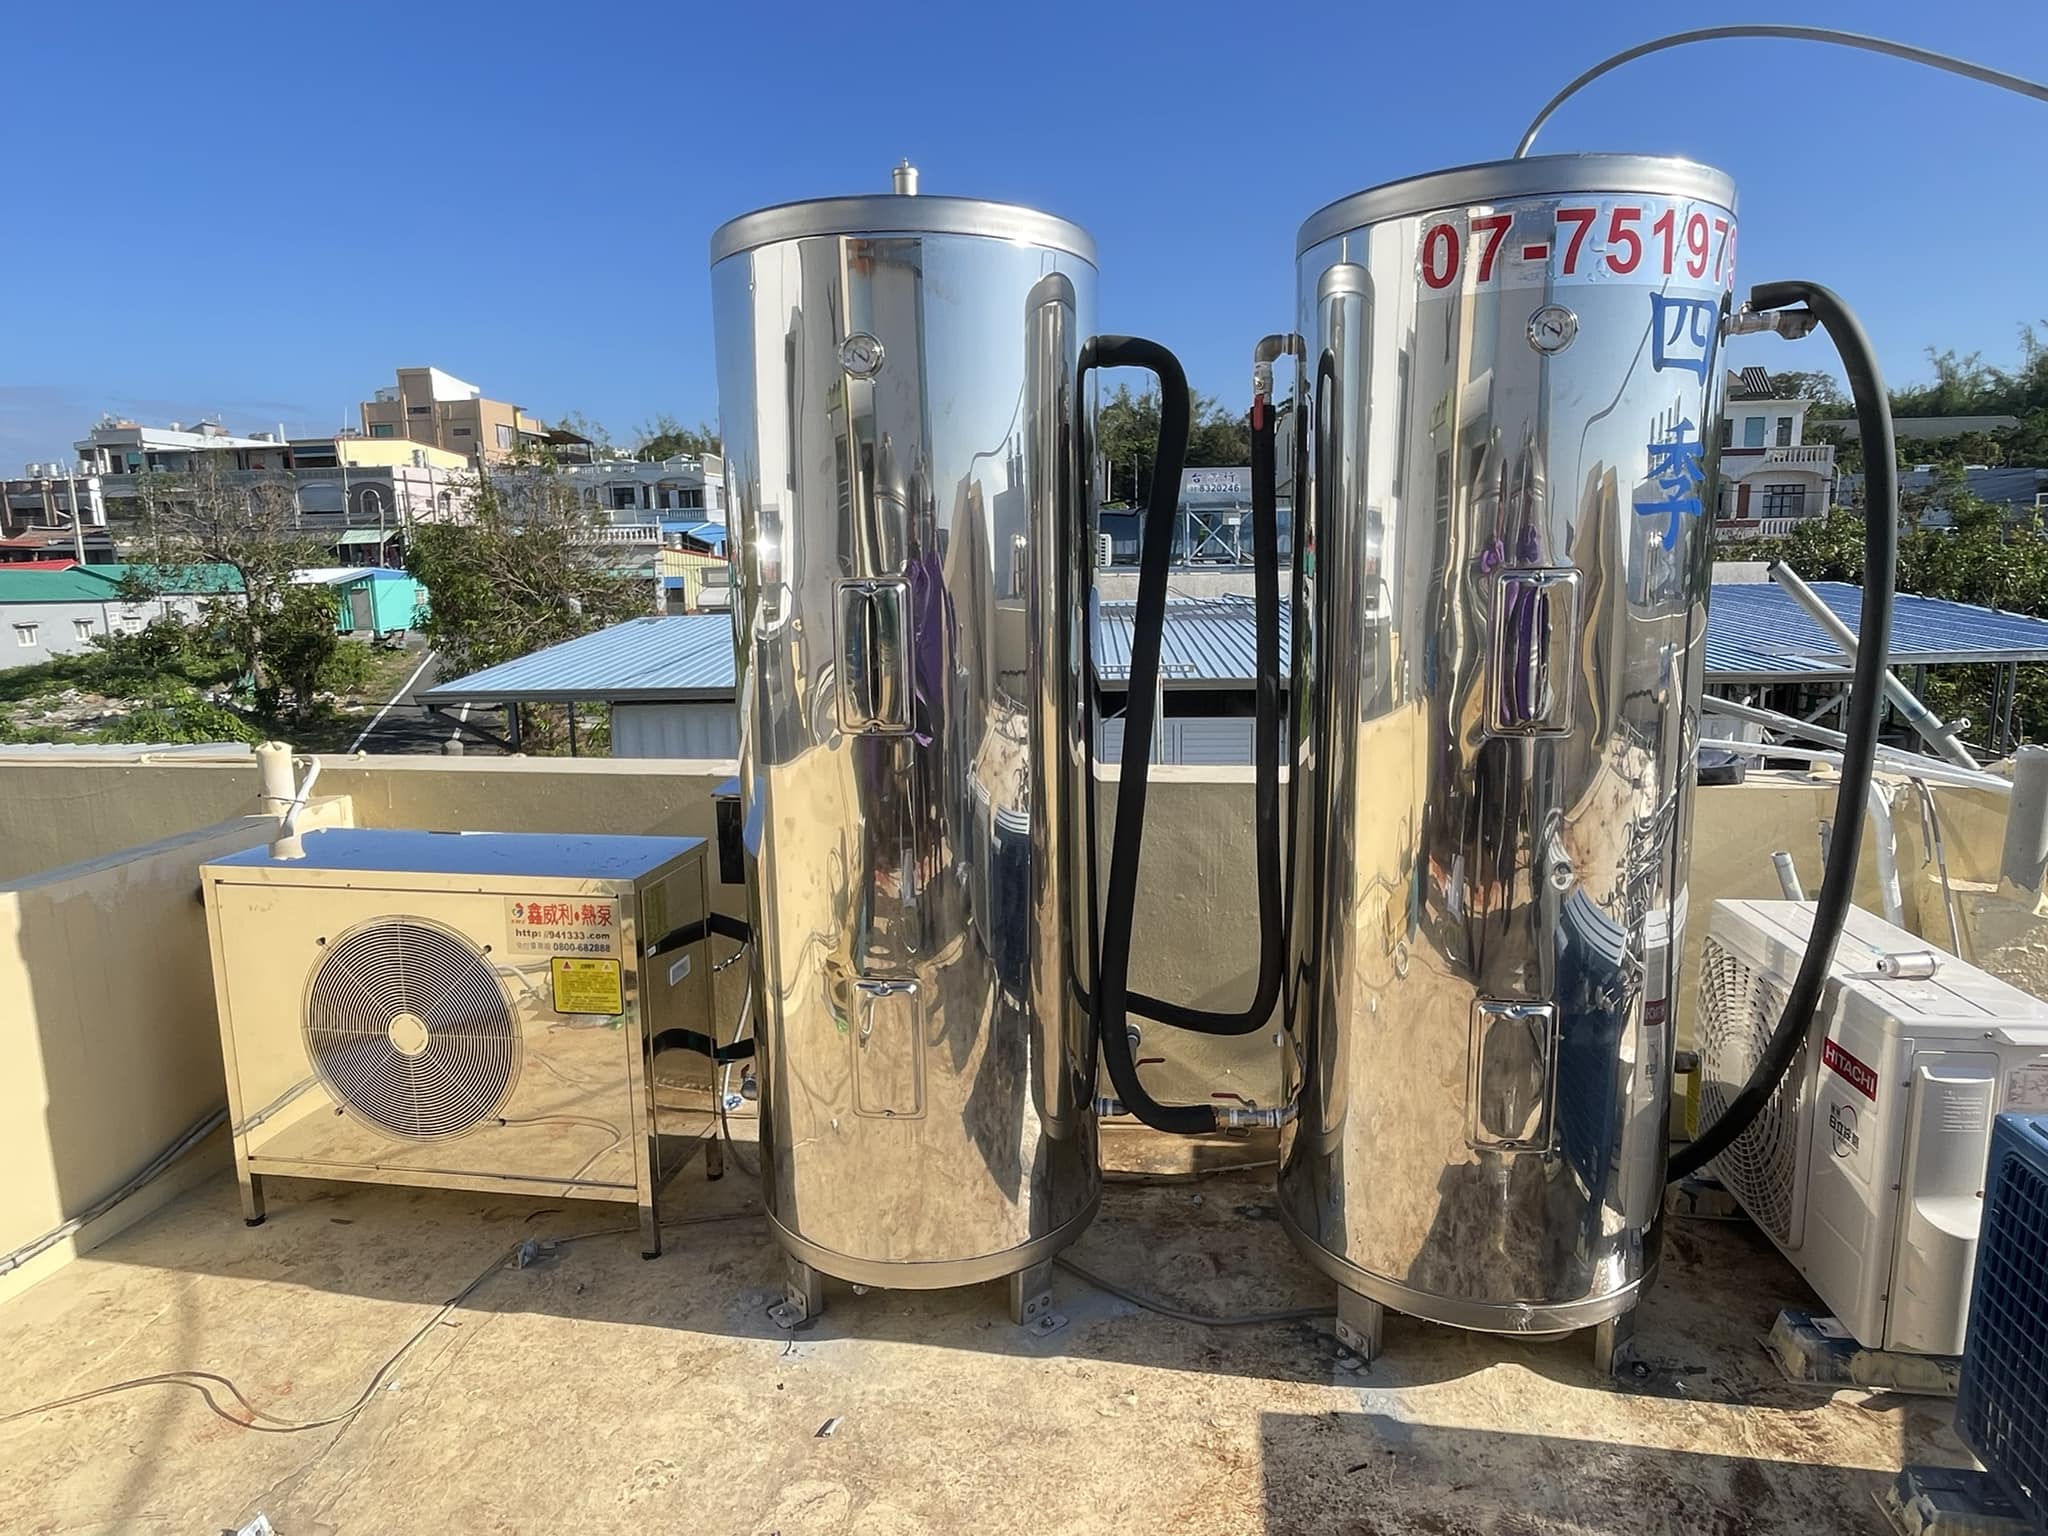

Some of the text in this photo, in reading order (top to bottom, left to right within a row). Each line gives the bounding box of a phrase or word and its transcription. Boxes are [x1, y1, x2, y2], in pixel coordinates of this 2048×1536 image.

[1633, 290, 1720, 552] 四季
[553, 943, 611, 953] 0800-682888
[1825, 1045, 1874, 1093] HITACHI
